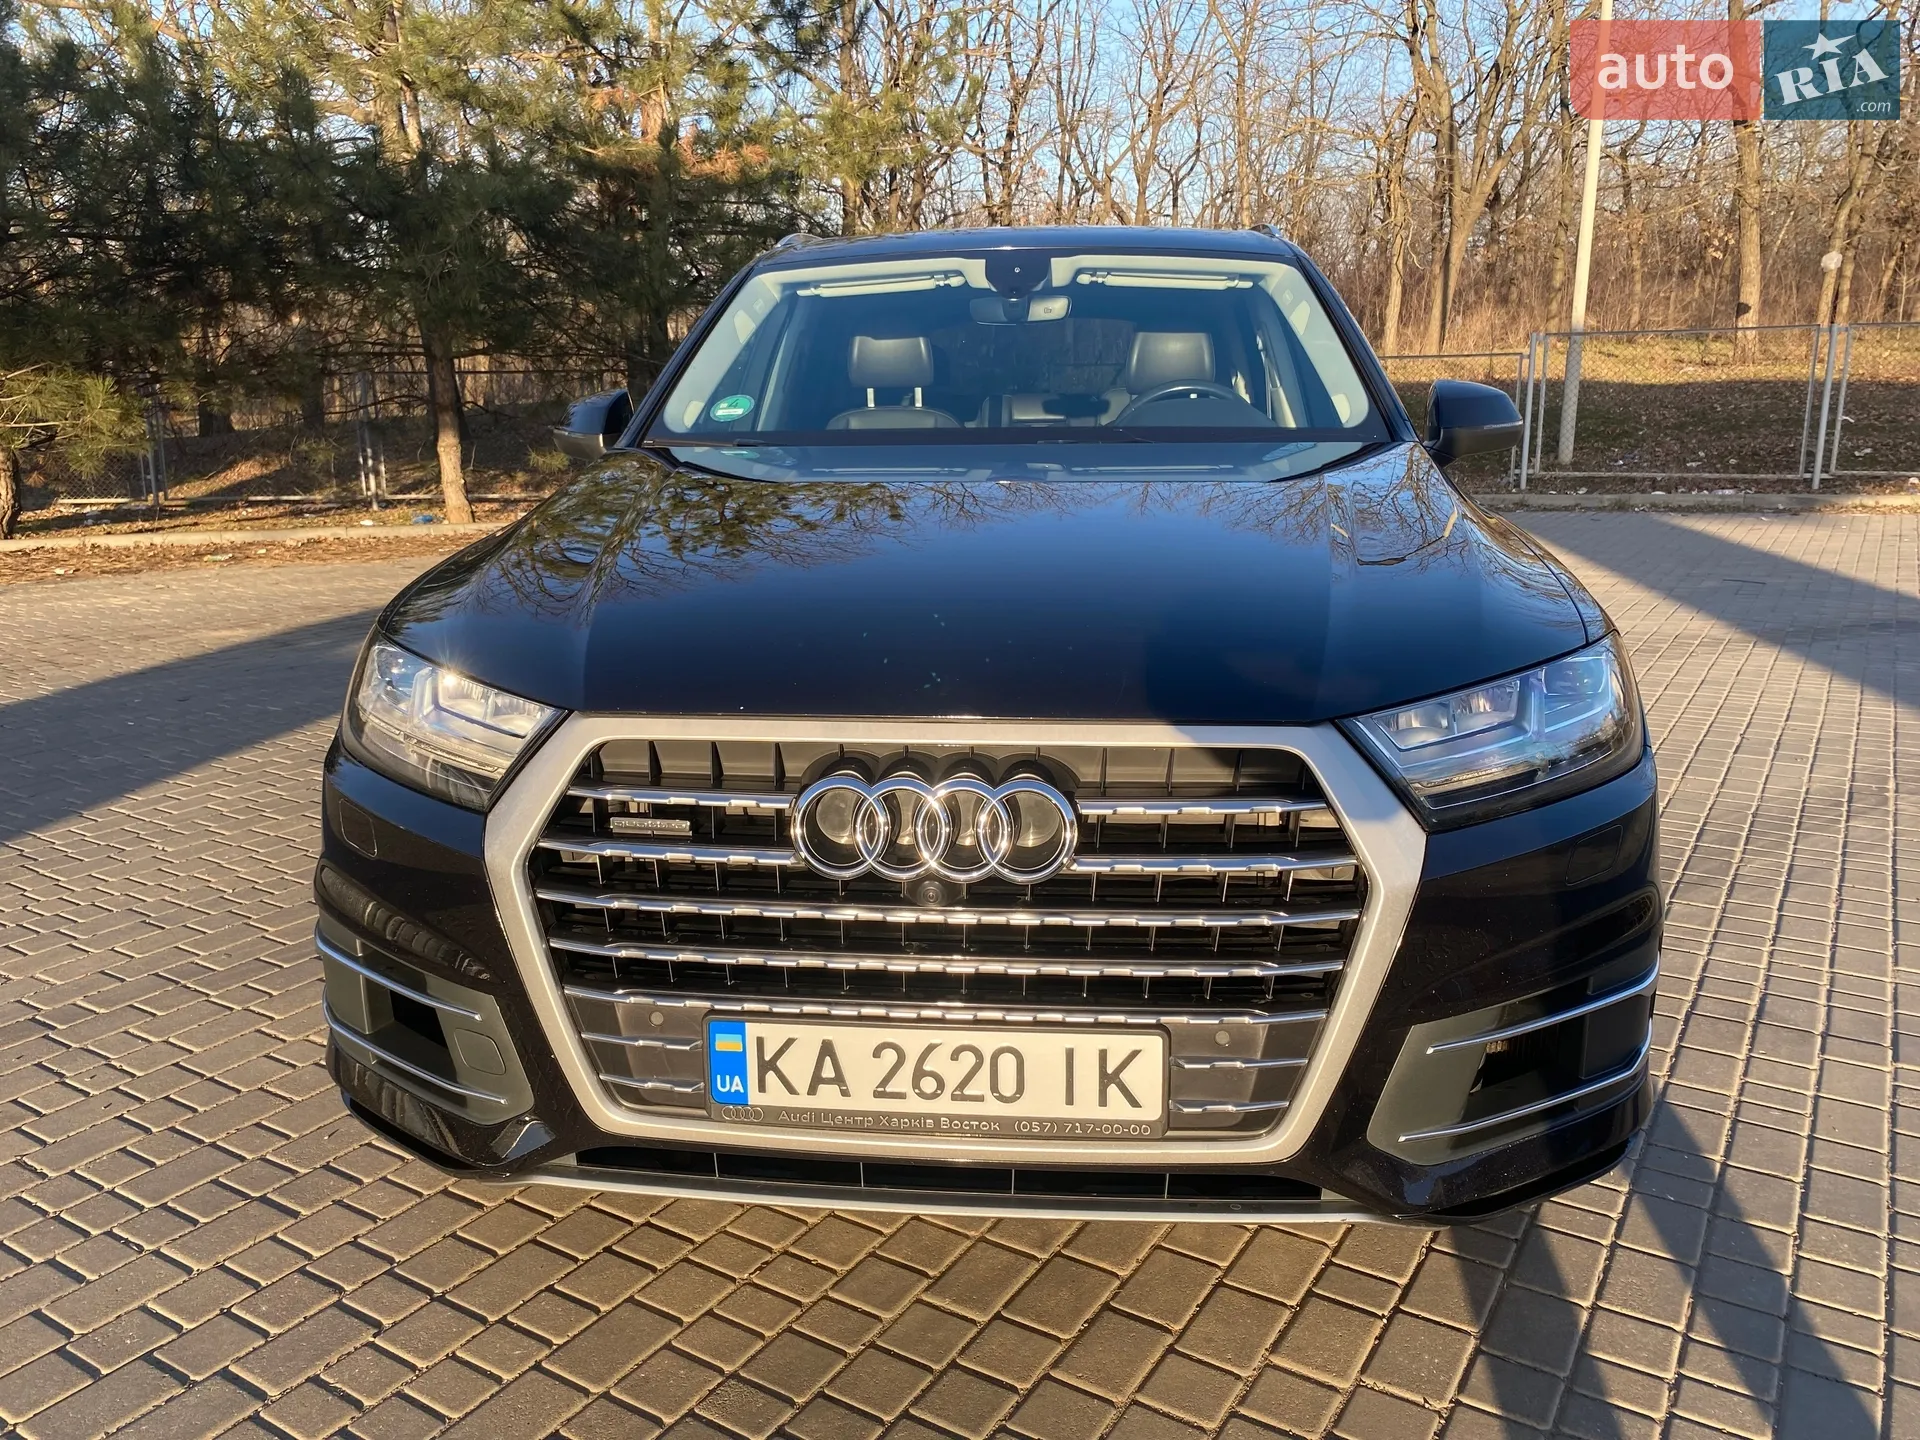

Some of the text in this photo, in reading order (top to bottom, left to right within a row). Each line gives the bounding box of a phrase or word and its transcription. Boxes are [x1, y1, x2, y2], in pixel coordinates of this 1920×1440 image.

[755, 1036, 852, 1098] KA
[872, 1041, 1026, 1104] 2620
[716, 1074, 745, 1094] UA
[778, 1110, 1151, 1136] Audi Центр Харків Восток (057) 717-00-00
